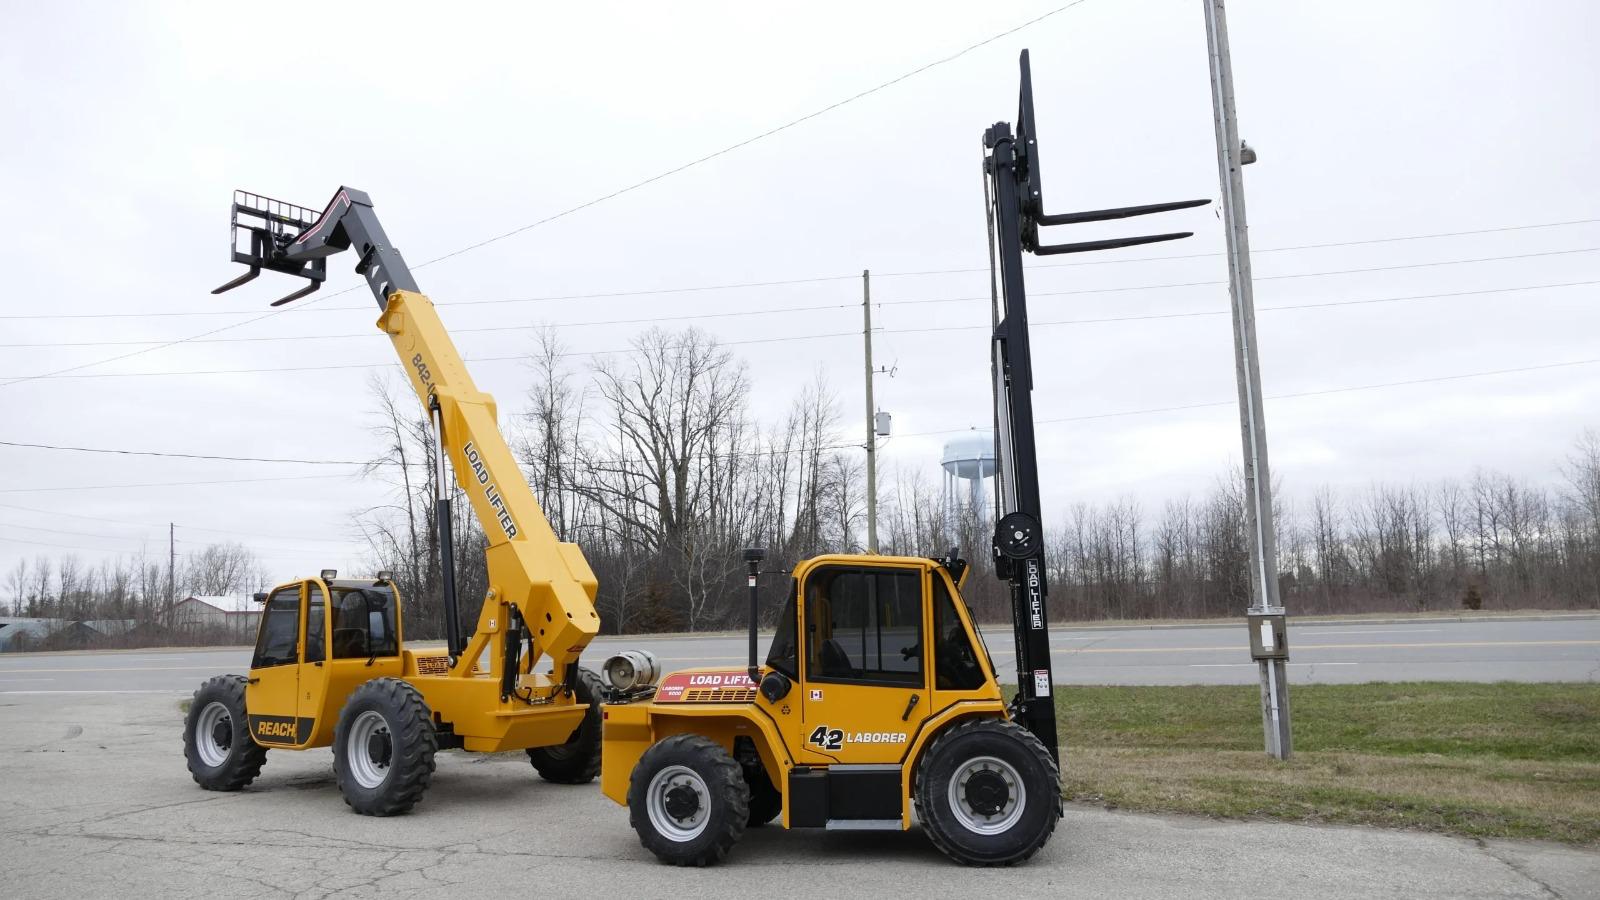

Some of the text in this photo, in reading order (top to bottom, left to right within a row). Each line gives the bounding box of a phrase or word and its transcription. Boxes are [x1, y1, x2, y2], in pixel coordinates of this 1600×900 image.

[463, 441, 518, 540] LOAD LIFTER
[1028, 561, 1042, 628] LOAD LIFTER
[690, 675, 756, 685] LOAD LIFT
[257, 721, 296, 737] REACH
[846, 732, 907, 743] LABORER
